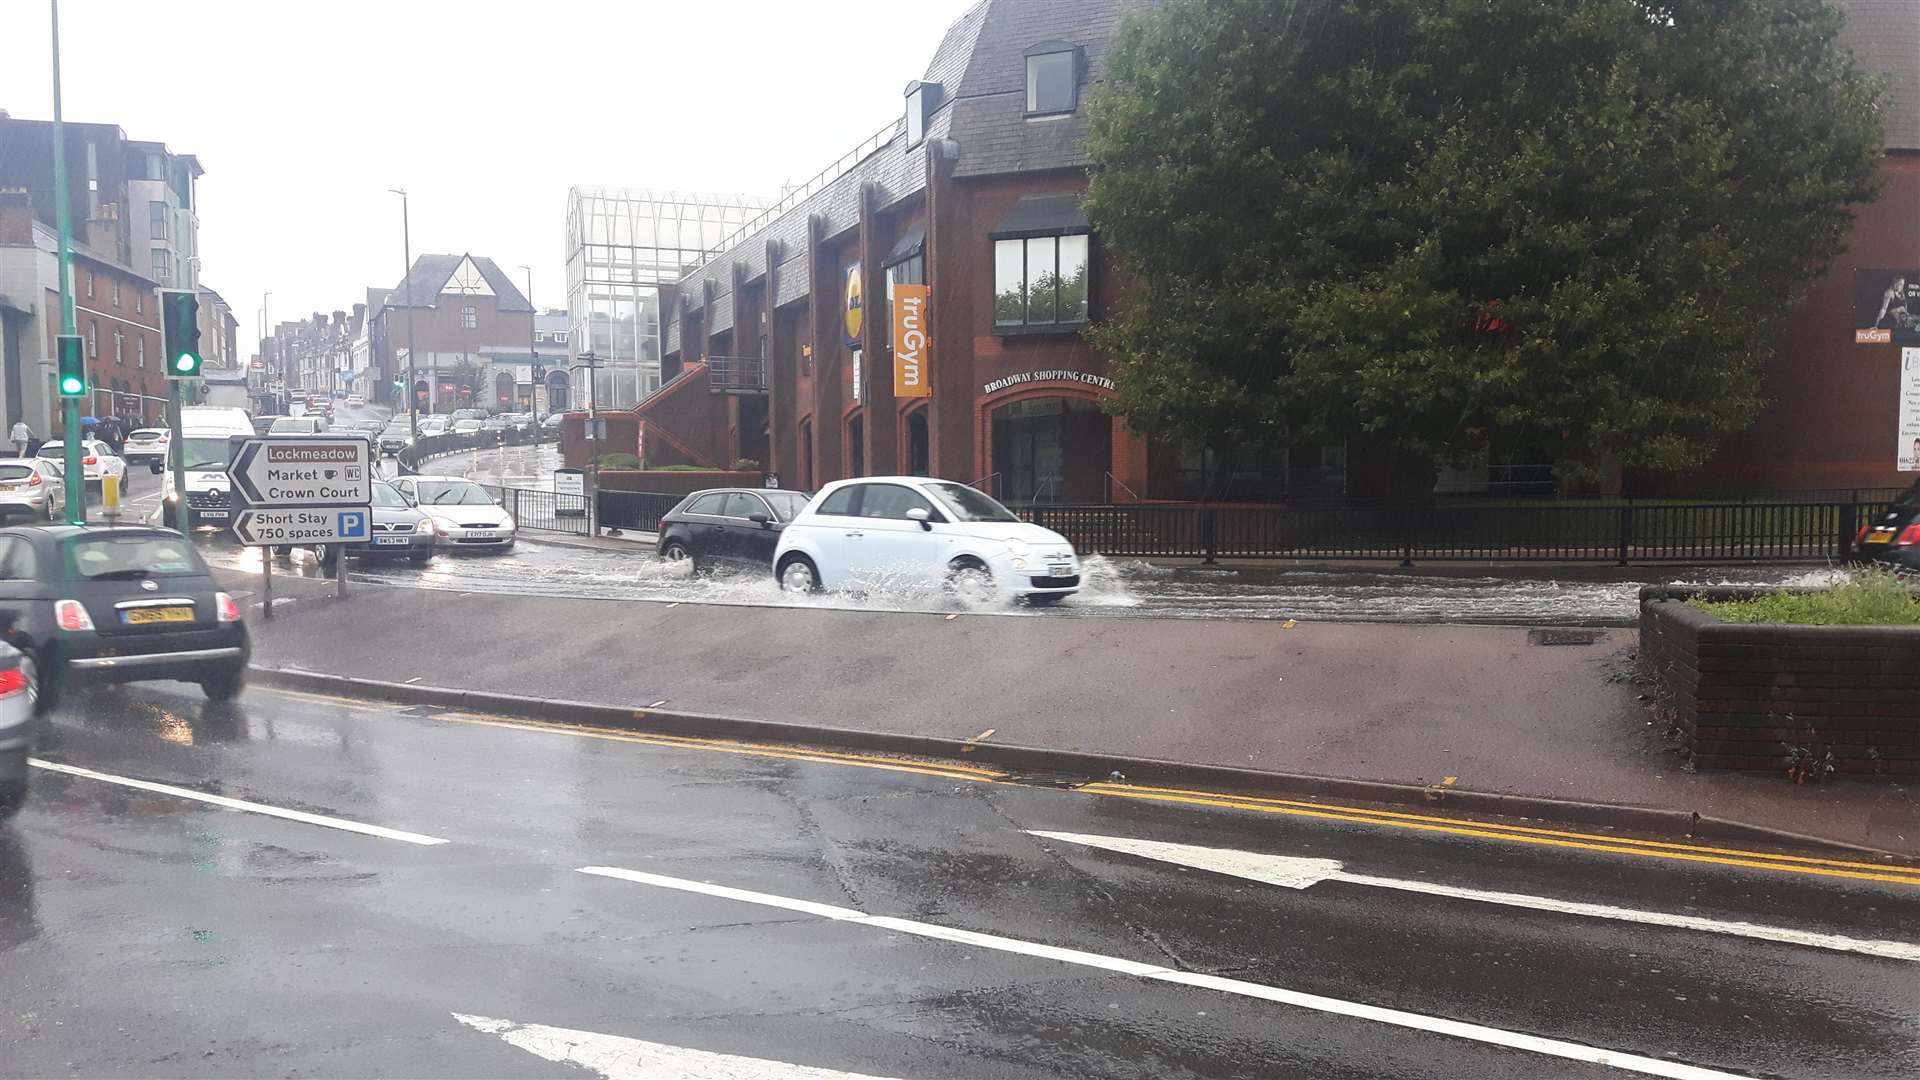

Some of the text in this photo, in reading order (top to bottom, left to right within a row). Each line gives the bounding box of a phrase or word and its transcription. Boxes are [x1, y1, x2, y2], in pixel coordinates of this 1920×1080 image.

[896, 296, 926, 386] truGym
[1857, 330, 1890, 342] truGym
[984, 370, 1116, 394] BROADWAY SHOPPING CENTRE
[269, 448, 356, 460] Lockmeadow
[268, 468, 360, 481] Market WC
[269, 486, 359, 499] Crown Court
[256, 512, 328, 525] Short Stay
[343, 514, 359, 535] P
[257, 528, 333, 540] 750 spaces
